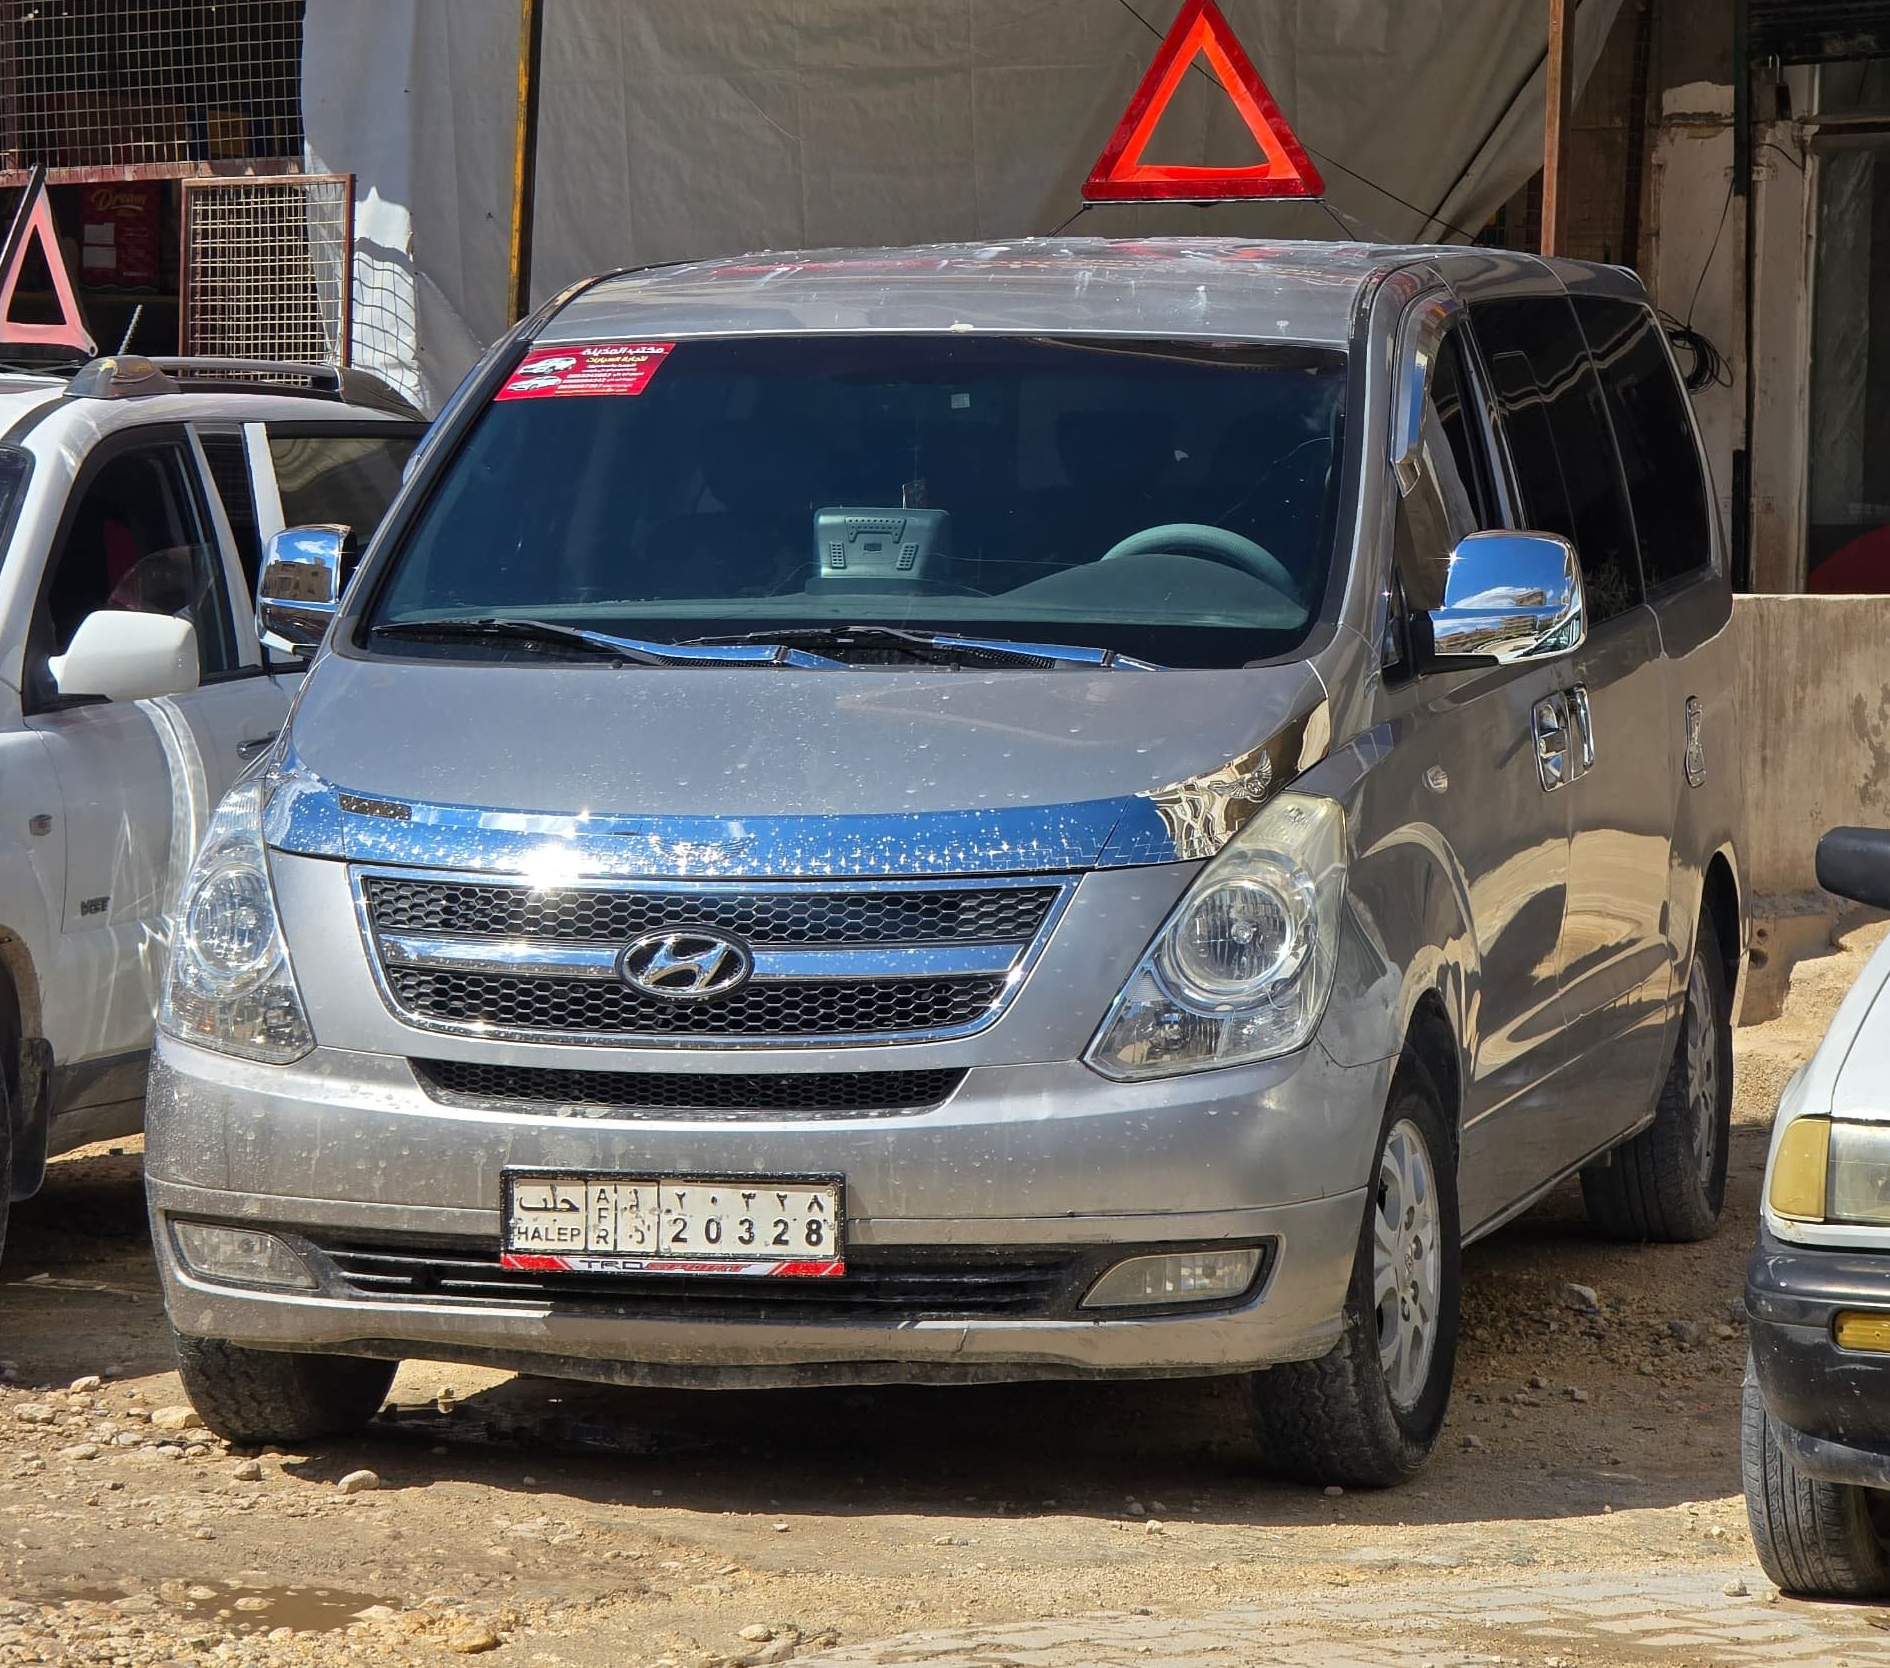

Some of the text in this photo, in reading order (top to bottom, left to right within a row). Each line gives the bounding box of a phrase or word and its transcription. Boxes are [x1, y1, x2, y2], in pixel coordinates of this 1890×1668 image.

[517, 1184, 580, 1222] حلب
[516, 1226, 581, 1243] HALEP
[671, 1217, 824, 1247] 20328
[579, 1259, 644, 1270] TRD
